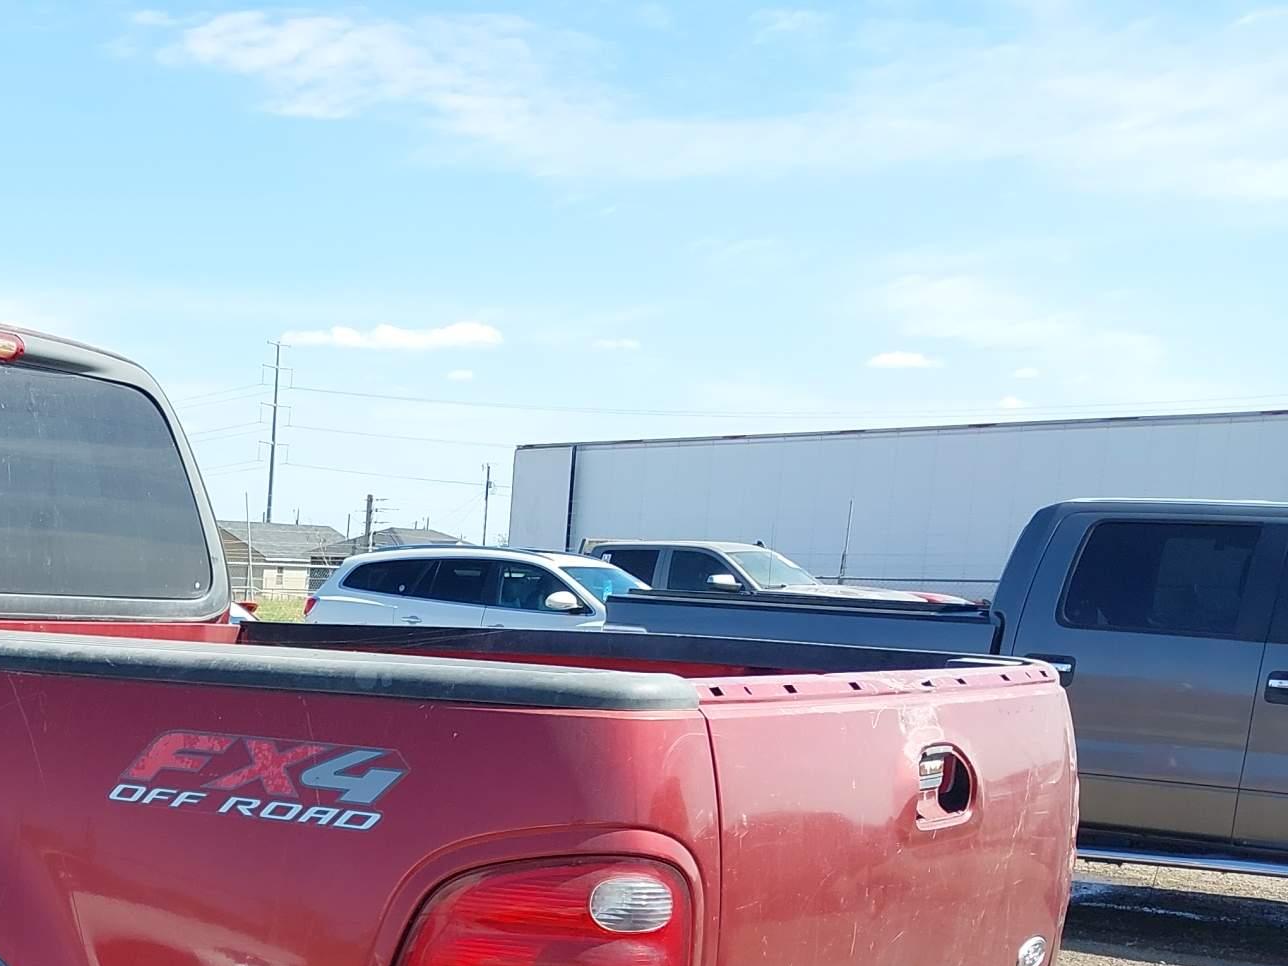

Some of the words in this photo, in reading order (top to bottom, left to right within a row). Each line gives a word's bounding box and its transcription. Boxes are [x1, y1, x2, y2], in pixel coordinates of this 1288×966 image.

[123, 732, 404, 804] FX4
[109, 783, 207, 808] OFF
[217, 796, 382, 830] ROAD
